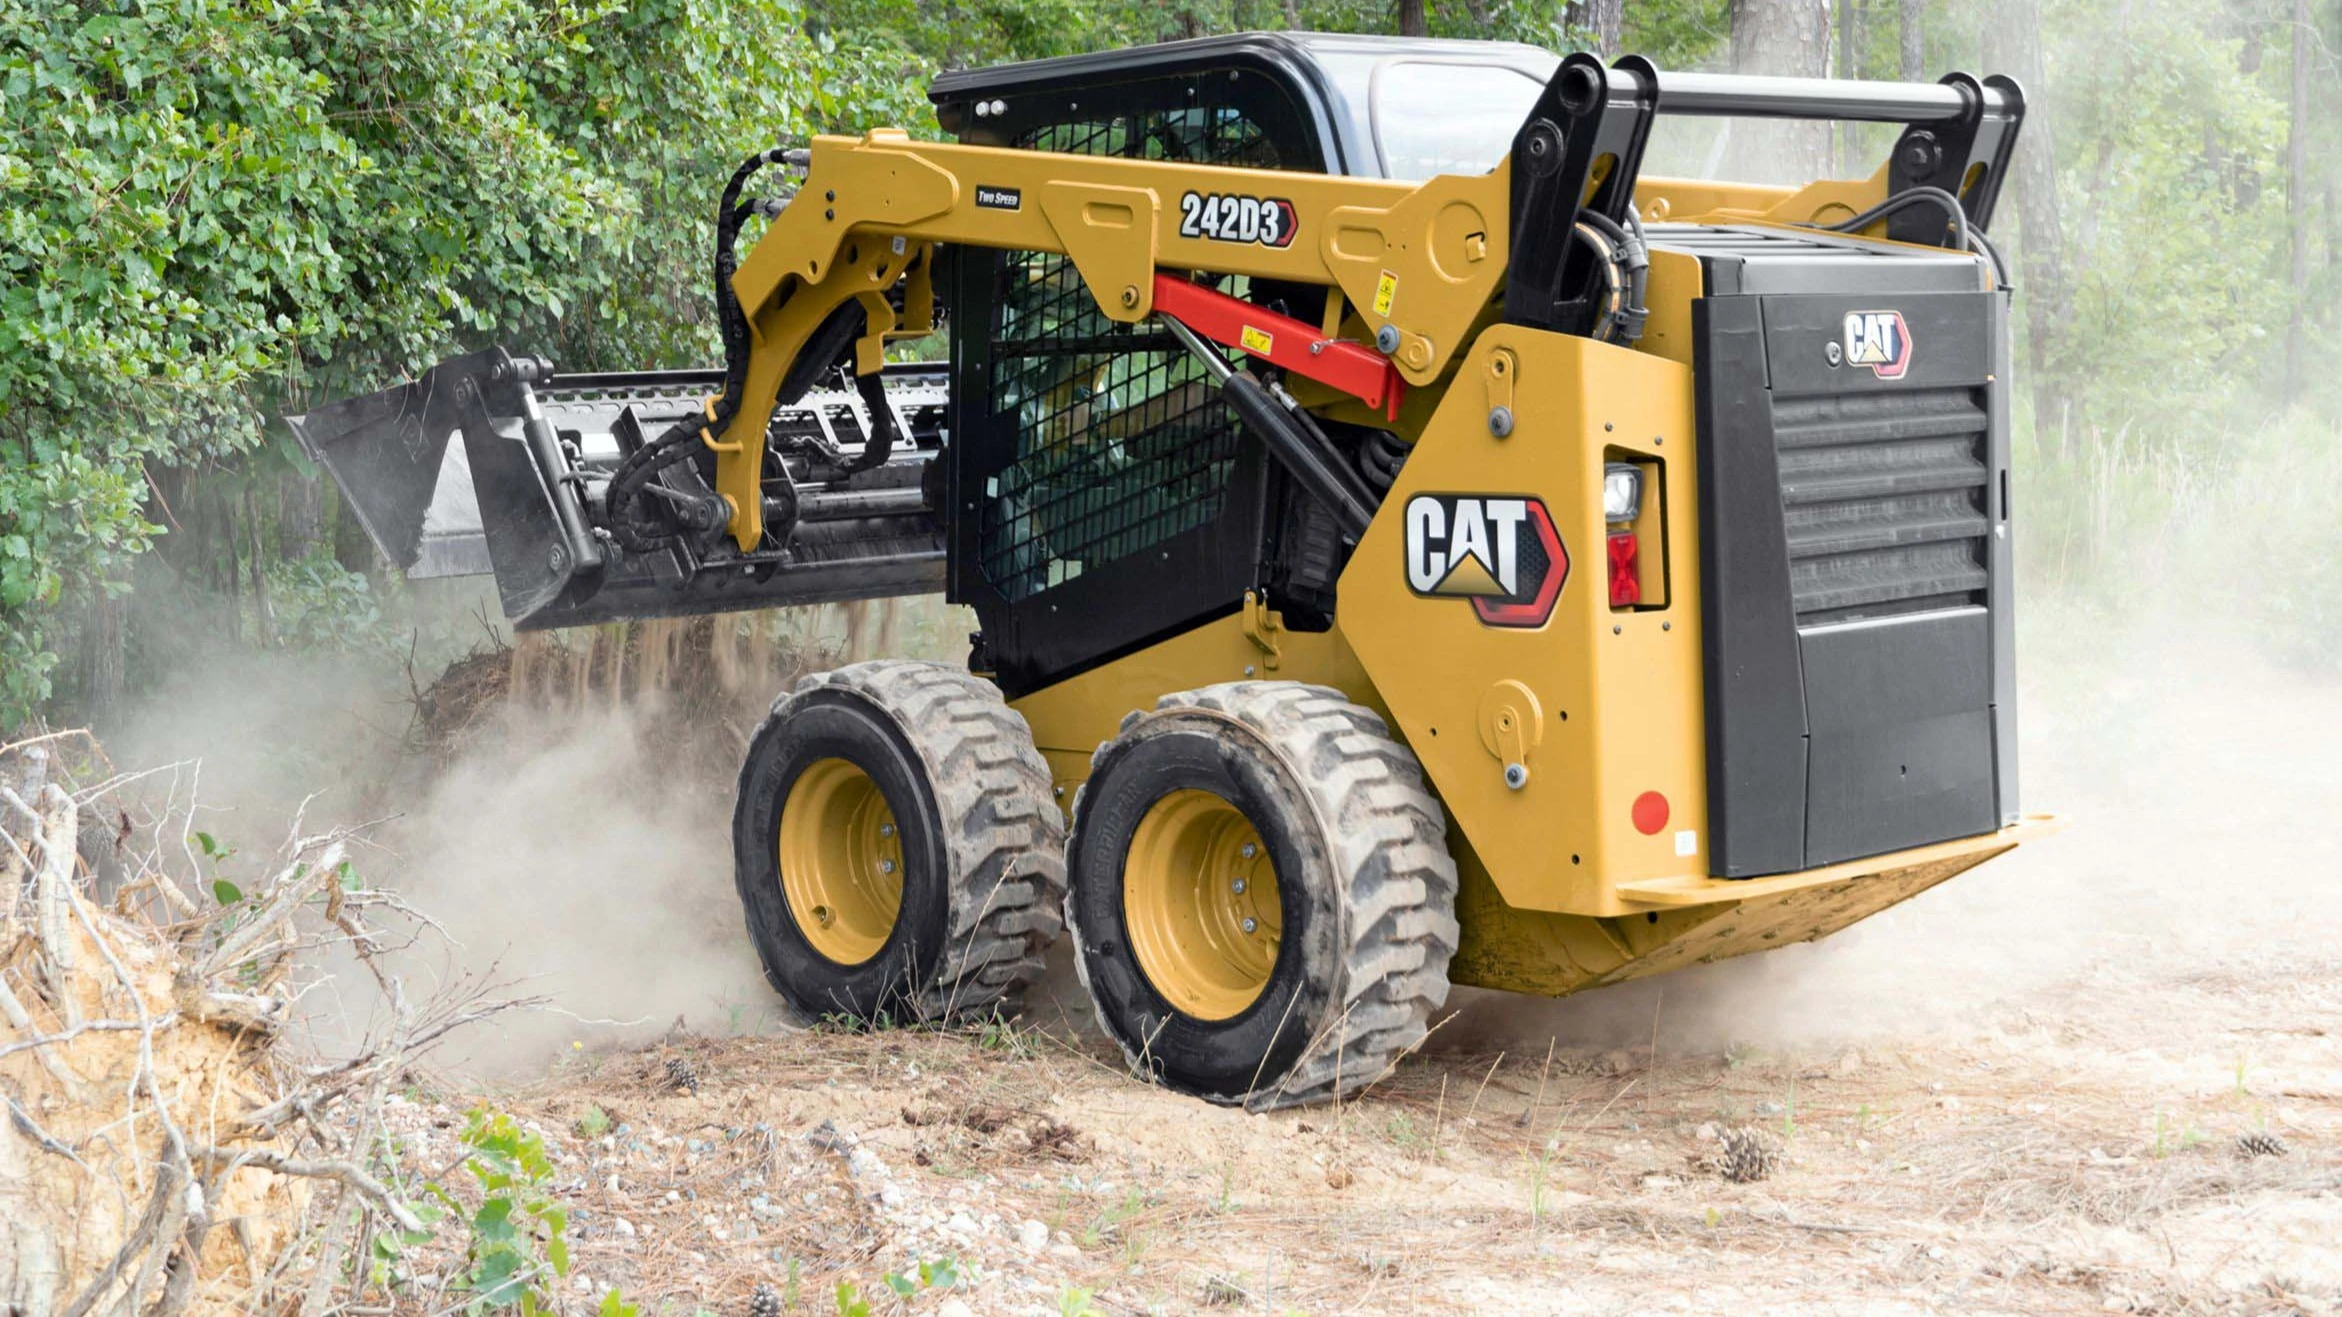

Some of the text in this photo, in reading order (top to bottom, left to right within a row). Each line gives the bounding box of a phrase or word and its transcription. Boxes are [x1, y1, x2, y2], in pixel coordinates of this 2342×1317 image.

[1181, 193, 1279, 244] 242D3
[1845, 313, 1895, 363] CAT
[1406, 496, 1526, 596] CAT
